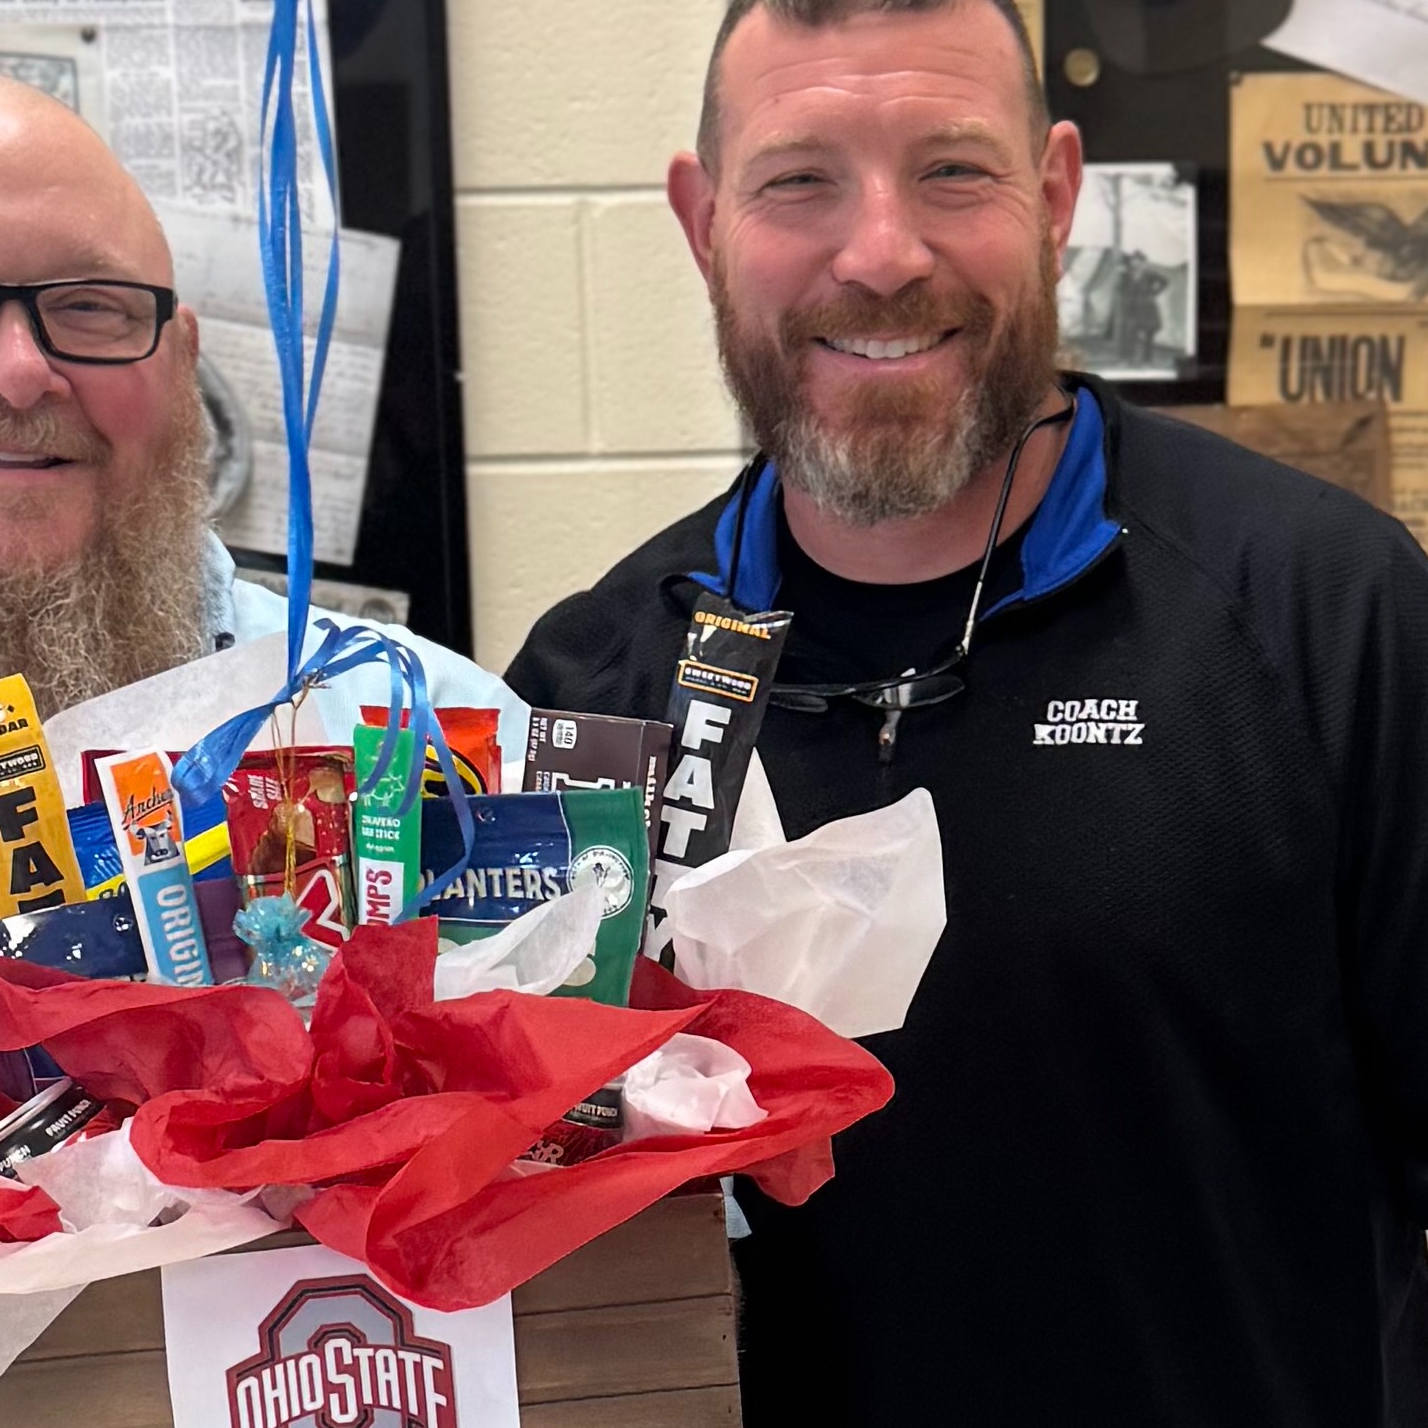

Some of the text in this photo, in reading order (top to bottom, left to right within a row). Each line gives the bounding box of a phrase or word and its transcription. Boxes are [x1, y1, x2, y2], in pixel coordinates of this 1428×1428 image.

[1303, 101, 1425, 136] UNITED
[1259, 332, 1405, 404] "UNION
[694, 610, 772, 642] ORIGINAL
[1046, 698, 1140, 723] COACH
[1032, 721, 1146, 746] KOONTZ
[365, 868, 394, 926] MPS
